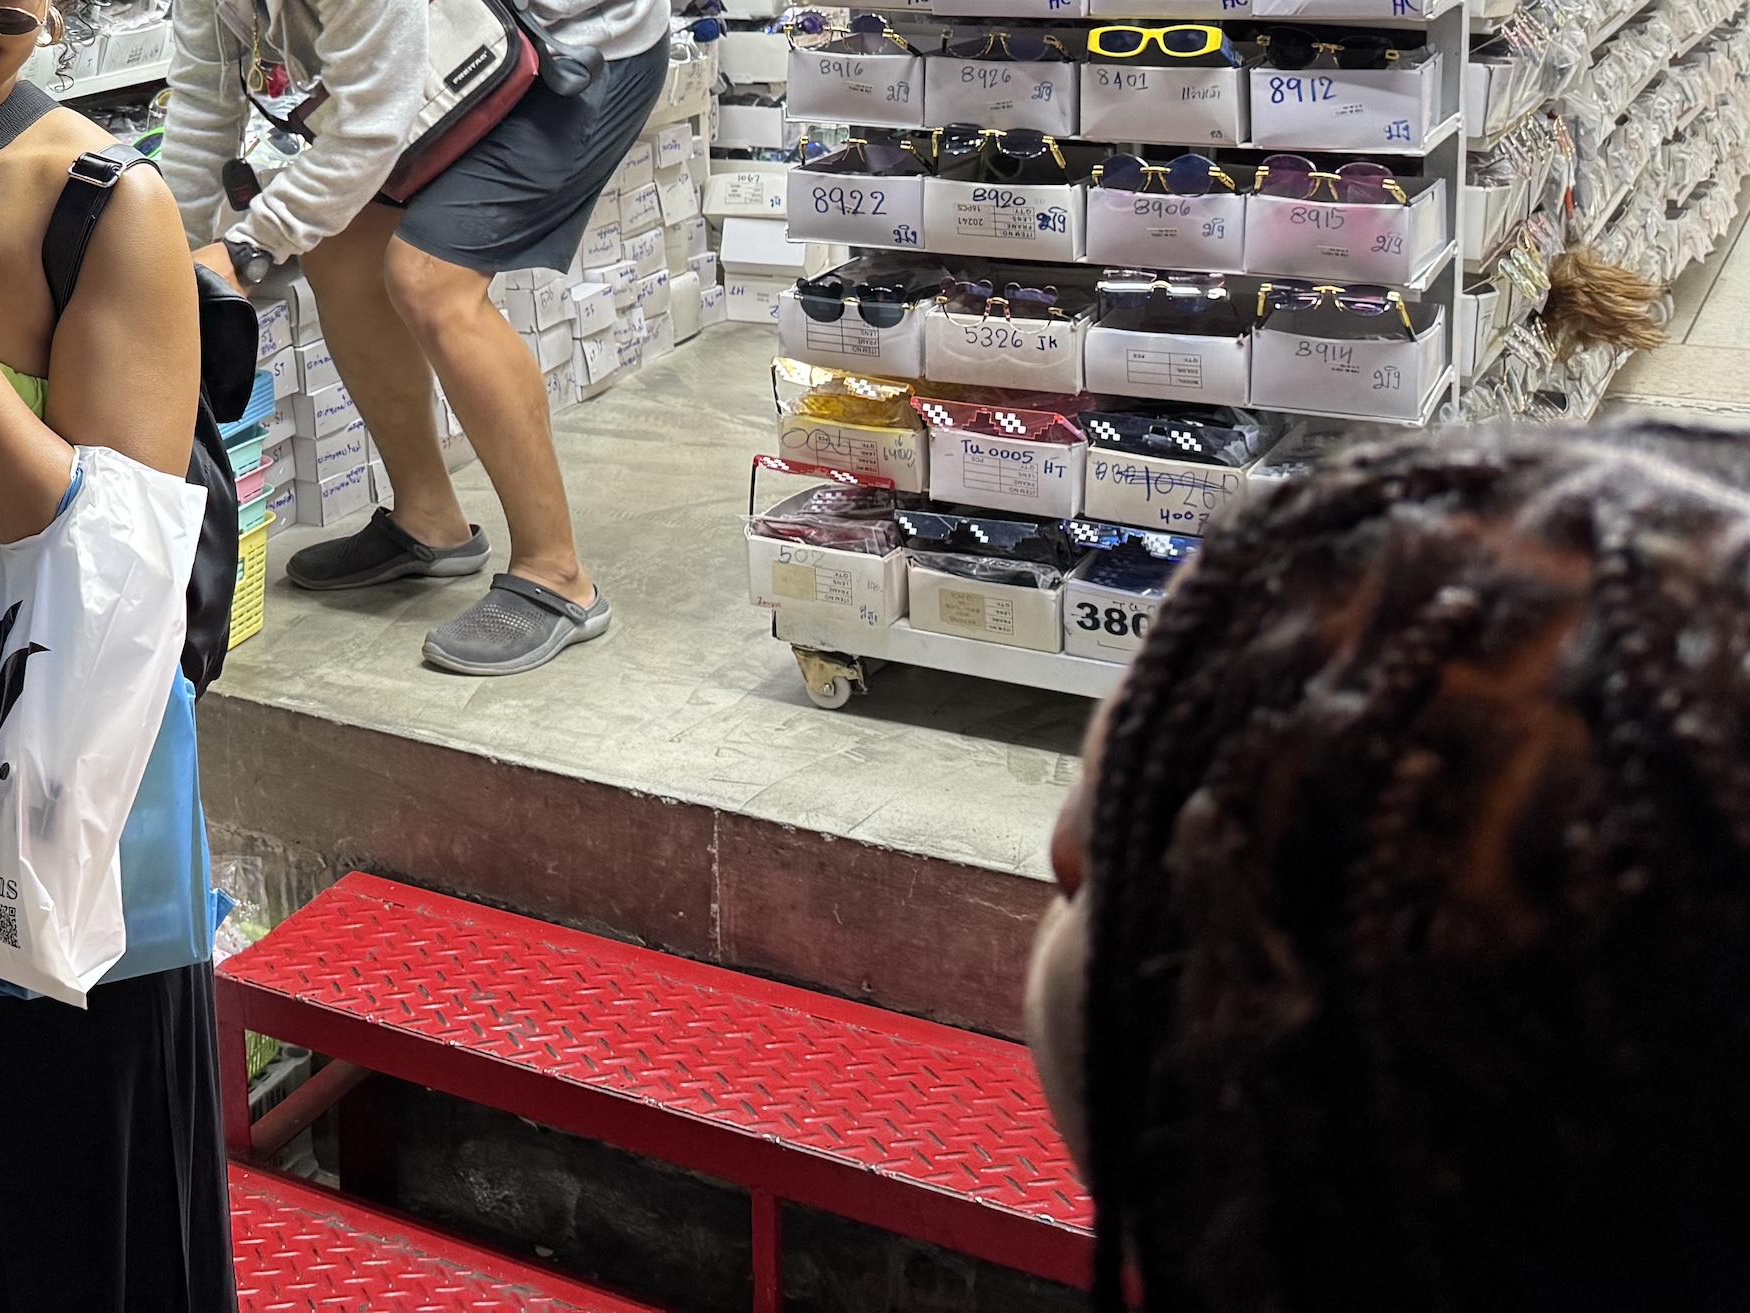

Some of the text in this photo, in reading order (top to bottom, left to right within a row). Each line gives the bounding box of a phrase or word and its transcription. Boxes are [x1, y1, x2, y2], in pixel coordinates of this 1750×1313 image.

[1269, 74, 1338, 104] 8912
[811, 185, 889, 217] 8922
[1043, 459, 1068, 478] HT
